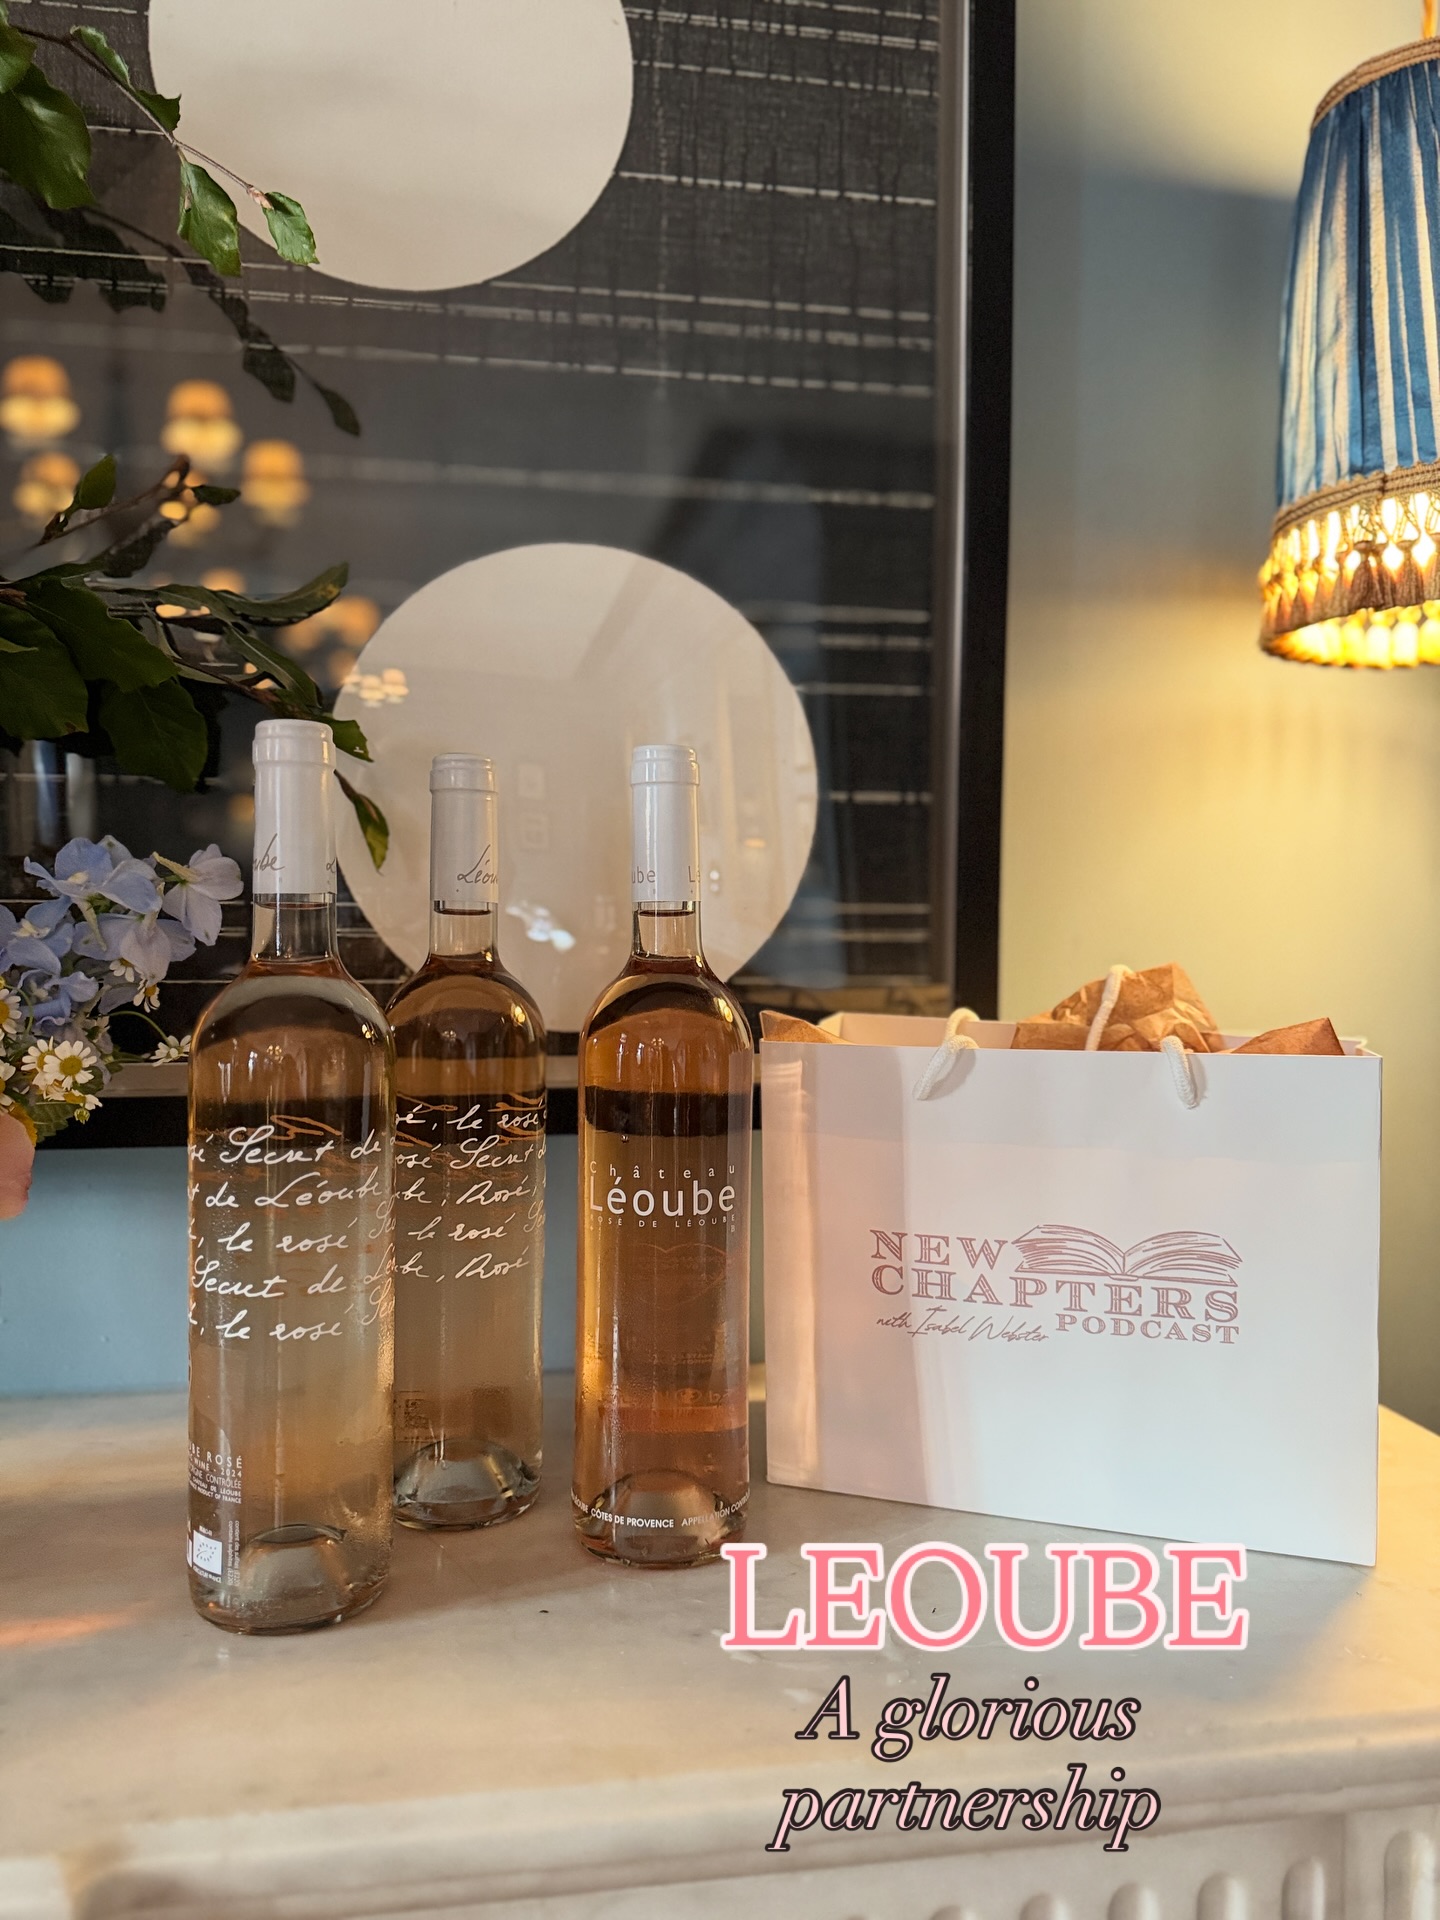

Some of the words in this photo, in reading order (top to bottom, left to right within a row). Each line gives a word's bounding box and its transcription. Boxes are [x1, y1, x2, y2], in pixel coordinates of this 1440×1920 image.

[447, 1104, 483, 1130] le
[219, 1125, 334, 1165] Secret
[350, 1128, 381, 1159] de
[450, 1135, 533, 1170] Secret
[589, 1160, 735, 1180] Château
[205, 1181, 240, 1207] de
[589, 1176, 736, 1217] Léoube
[217, 1222, 253, 1252] le
[275, 1217, 358, 1254] rosé
[408, 1216, 437, 1240] le
[448, 1212, 516, 1241] rosé
[638, 1220, 657, 1228] DE
[675, 1213, 736, 1229] LÉOUBE
[869, 1229, 1008, 1270] NEW
[191, 1255, 287, 1299] Secret
[307, 1264, 347, 1294] de
[871, 1264, 1239, 1323] CHAPTERS
[215, 1310, 251, 1340] le
[269, 1303, 353, 1342] rosé
[907, 1304, 975, 1338] Isabel
[968, 1315, 1049, 1342] Webster
[1055, 1313, 1240, 1344] PODCAST
[206, 1450, 242, 1469] ROSÉ
[590, 1507, 613, 1523] CÔTES
[614, 1514, 625, 1525] DE
[626, 1516, 675, 1529] PROVENCE
